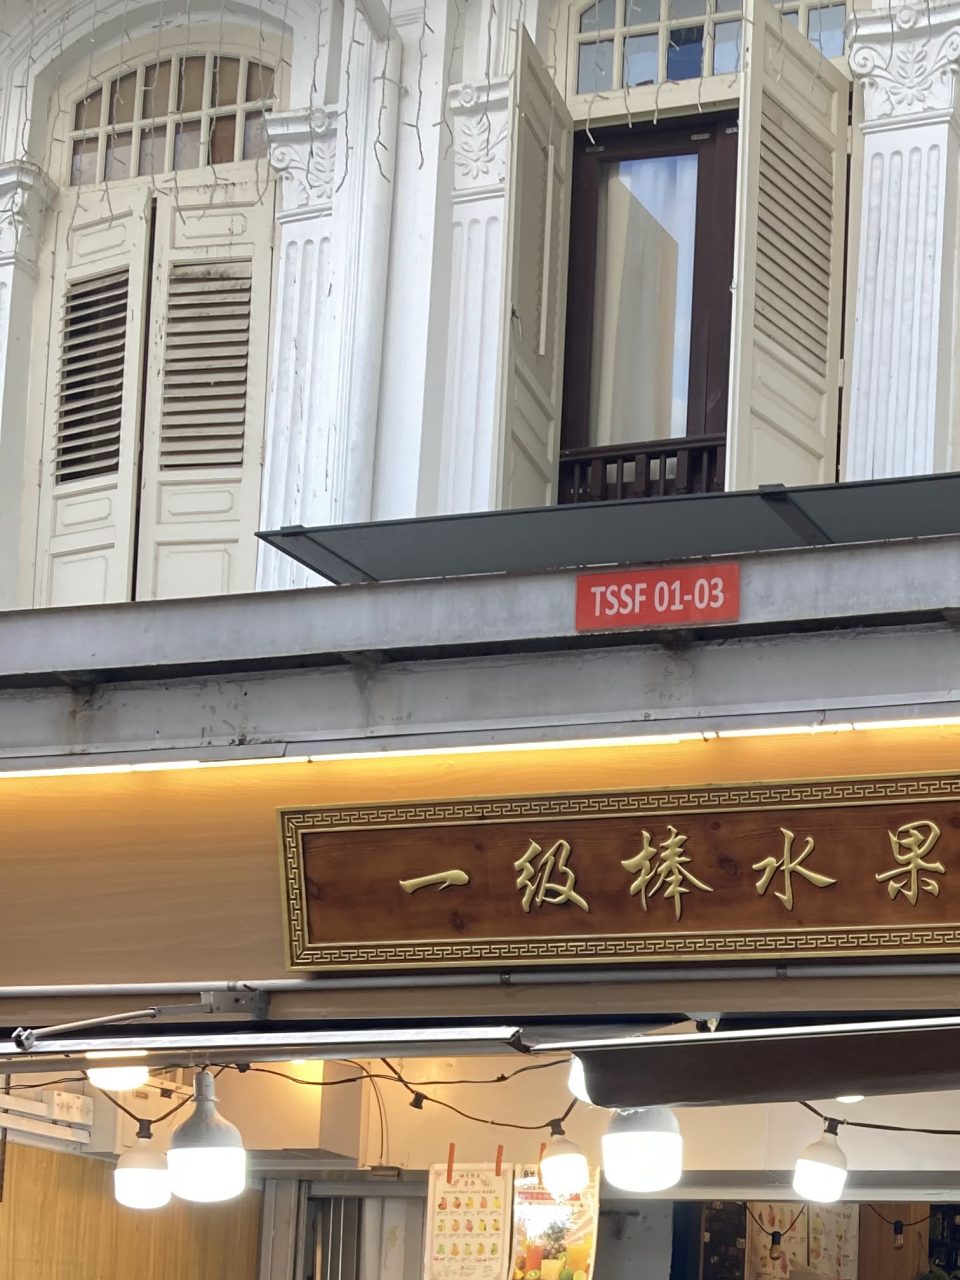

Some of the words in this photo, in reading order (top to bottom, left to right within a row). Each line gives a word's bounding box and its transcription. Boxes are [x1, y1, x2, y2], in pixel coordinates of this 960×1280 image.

[591, 583, 647, 617] TSSF
[654, 576, 724, 613] 01-03
[399, 820, 946, 922] 一级棒水果
